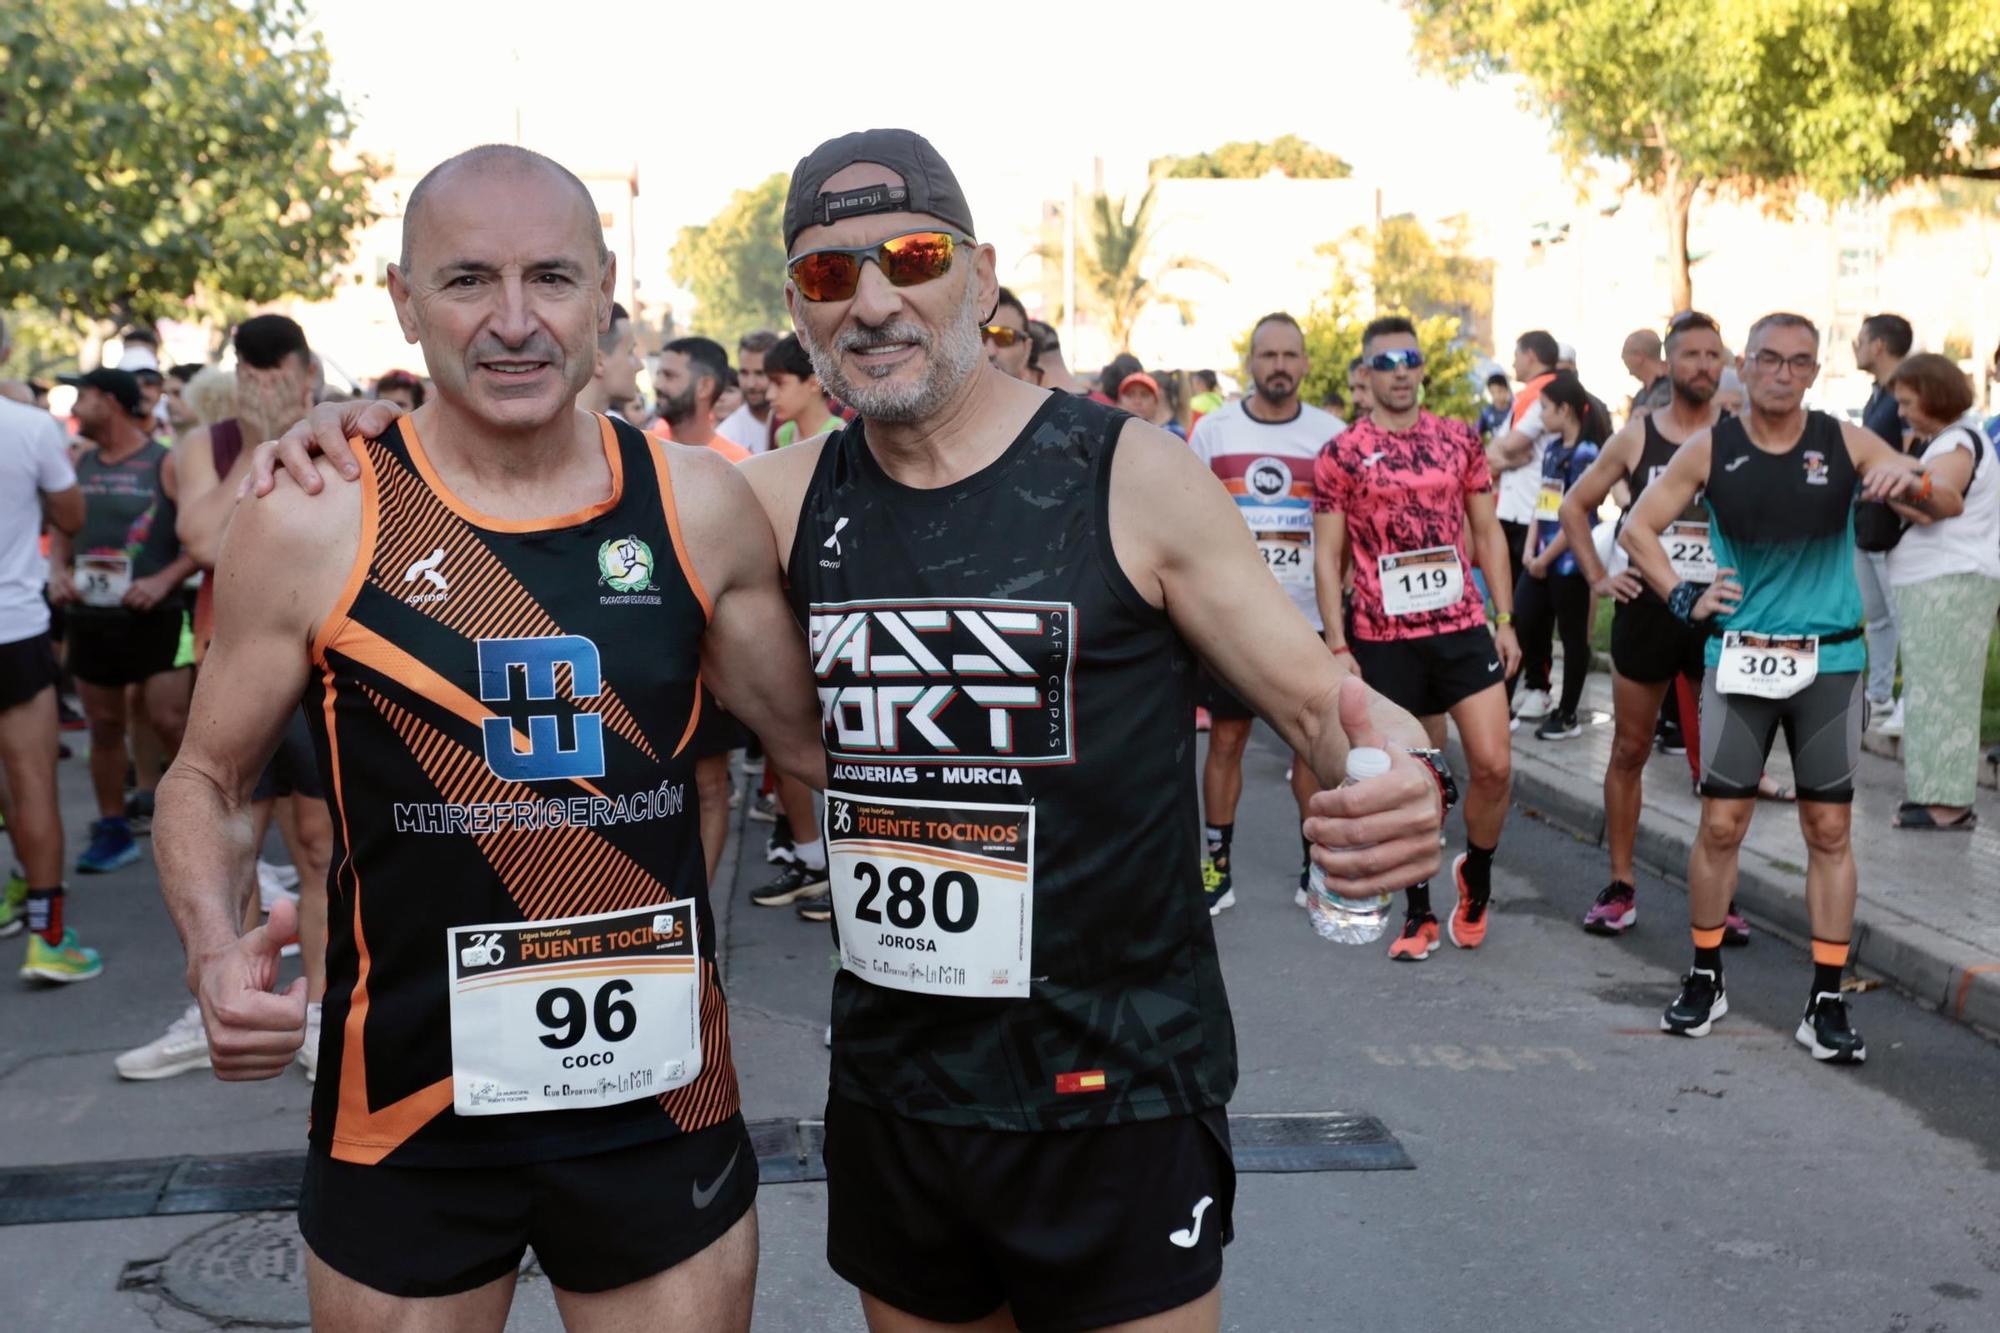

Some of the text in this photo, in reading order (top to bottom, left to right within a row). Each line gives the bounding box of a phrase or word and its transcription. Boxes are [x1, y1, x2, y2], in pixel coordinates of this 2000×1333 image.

[1399, 569, 1447, 592] 119
[1739, 655, 1797, 676] 303
[1048, 675, 1060, 748] COPAS
[833, 763, 918, 783] ALQUERIAS
[942, 767, 1023, 786] MURCIA
[859, 816, 1018, 843] PUENTE TOCINOS
[853, 861, 979, 933] 280
[521, 935, 601, 961] PUENTE
[878, 934, 937, 952] JOROSA
[536, 979, 637, 1049] 96
[562, 1051, 614, 1069] COCO
